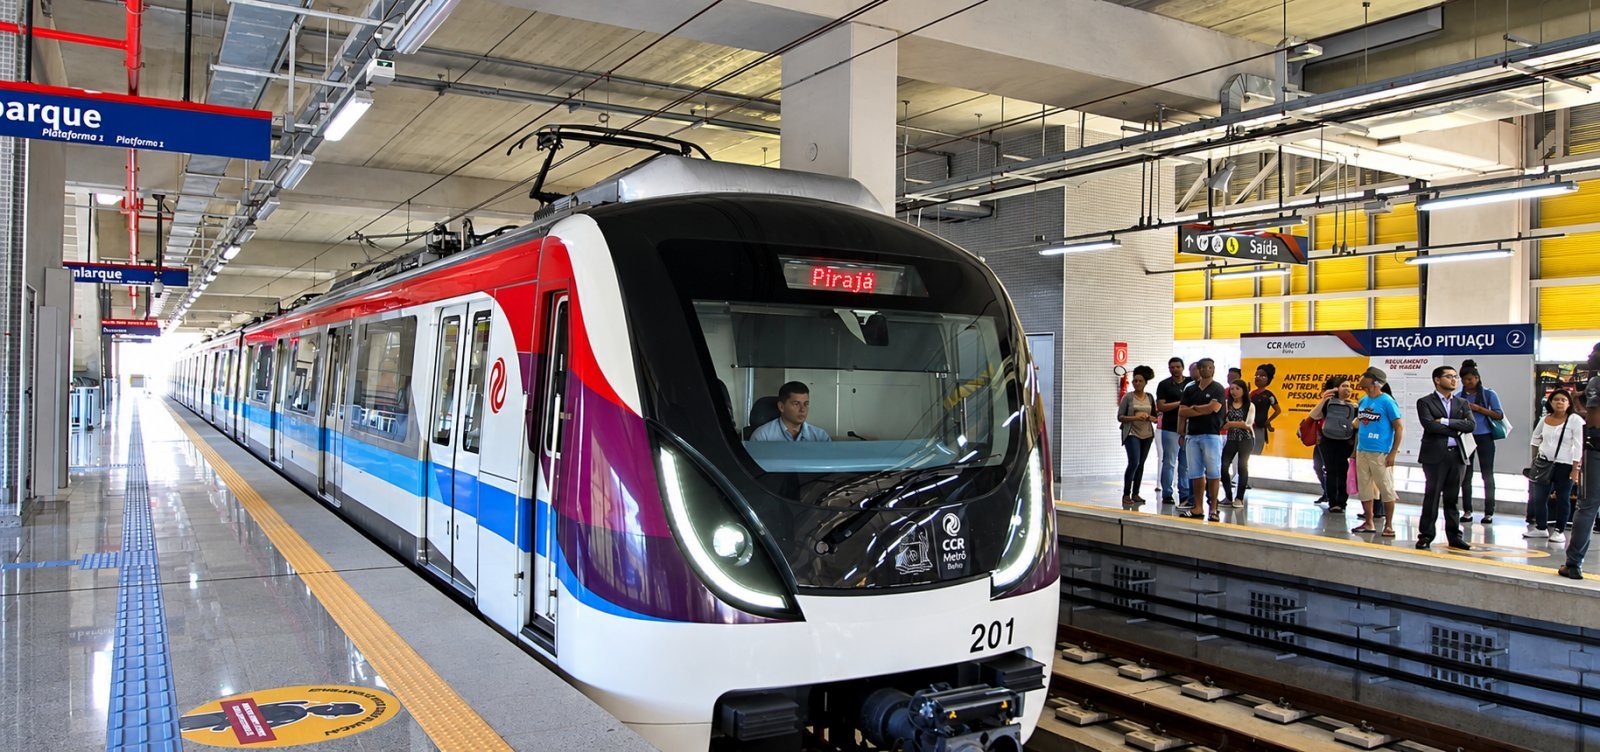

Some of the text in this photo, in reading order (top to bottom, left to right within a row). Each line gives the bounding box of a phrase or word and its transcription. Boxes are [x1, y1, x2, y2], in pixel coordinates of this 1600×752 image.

[0, 101, 102, 131] arque
[42, 128, 97, 141] Plataforma
[1250, 239, 1278, 256] Saída
[812, 267, 874, 293] Pirajá
[1267, 341, 1282, 350] CCR
[1375, 333, 1520, 351] ESTAÇÃO PITUAÇU 2
[1284, 373, 1311, 382] ANTES
[1312, 374, 1324, 382] DE
[1281, 382, 1294, 391] NO
[942, 537, 965, 551] CCR
[970, 617, 1014, 653] 201
